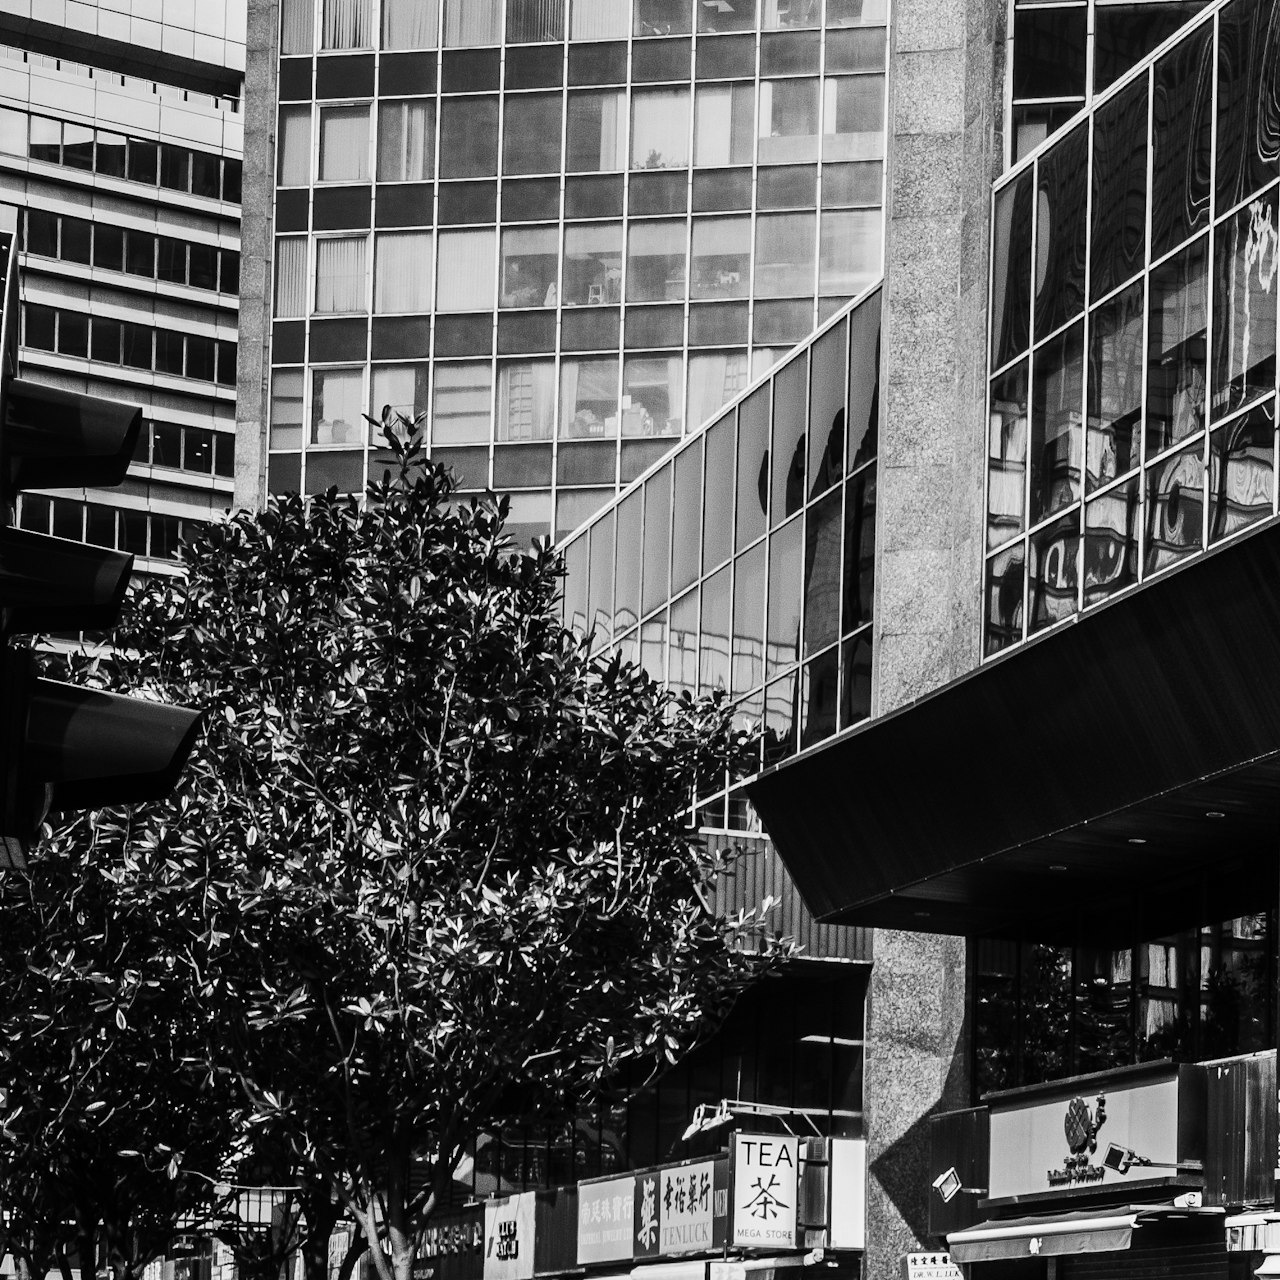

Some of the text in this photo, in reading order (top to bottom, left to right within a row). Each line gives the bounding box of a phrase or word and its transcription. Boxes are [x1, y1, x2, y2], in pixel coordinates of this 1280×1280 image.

[741, 1141, 793, 1168] TEA
[741, 1173, 791, 1220] 茶
[662, 1222, 710, 1247] TENLUCK
[737, 1228, 793, 1240] MEGA STORE
